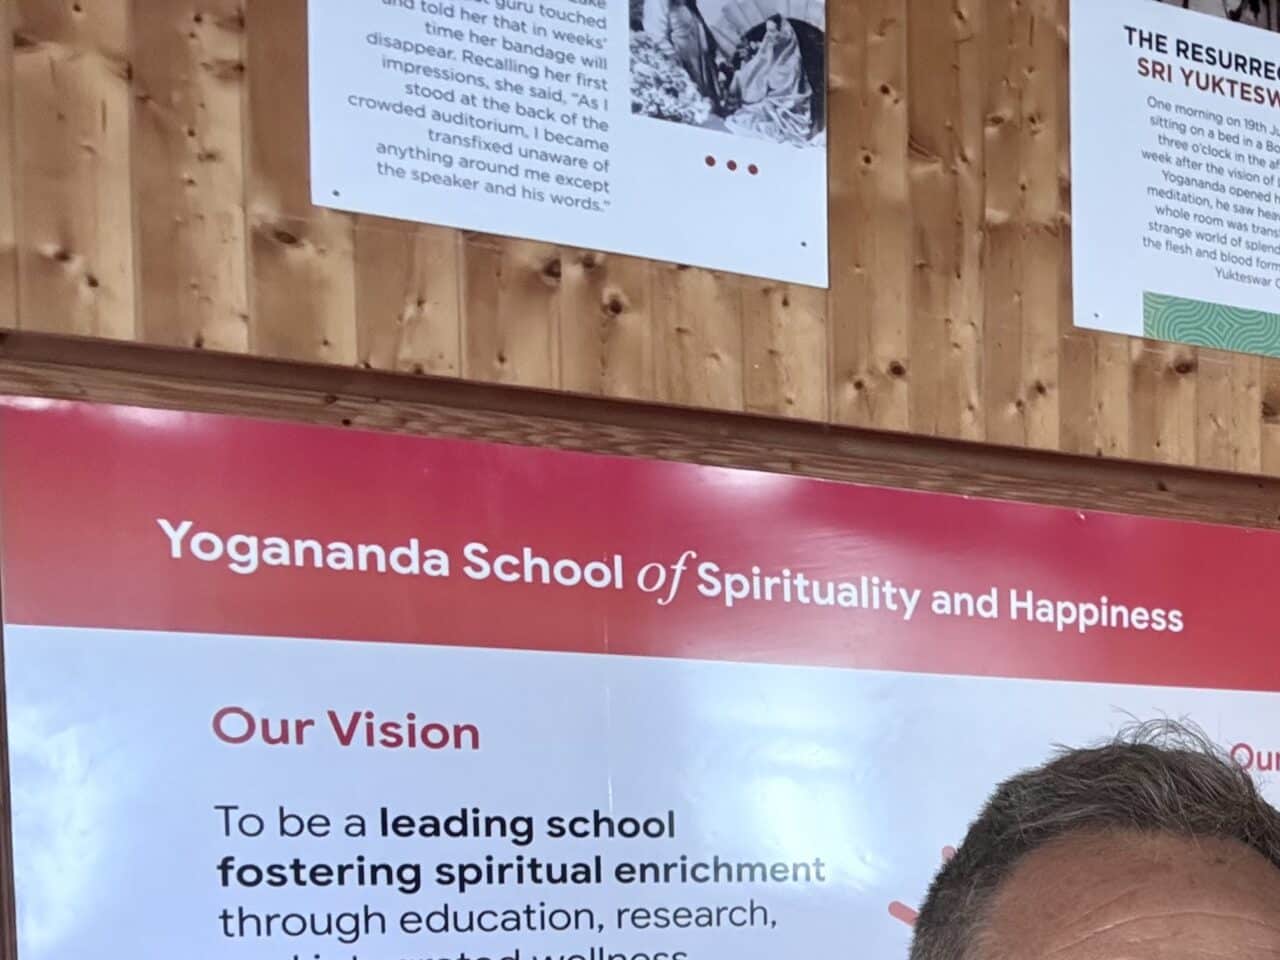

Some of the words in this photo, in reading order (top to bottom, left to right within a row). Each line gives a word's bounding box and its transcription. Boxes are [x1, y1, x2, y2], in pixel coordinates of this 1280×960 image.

[420, 0, 455, 18] told
[460, 7, 487, 24] her
[492, 14, 527, 34] that
[532, 23, 547, 37] in
[494, 0, 532, 14] guru
[538, 4, 607, 30] touched
[424, 21, 464, 41] time
[468, 28, 497, 46] her
[501, 35, 576, 64] bandage
[580, 55, 607, 69] will
[1123, 25, 1167, 54] THE
[382, 57, 490, 89] impressions,
[494, 77, 524, 95] she
[604, 98, 608, 110] I
[462, 48, 539, 80] Recalling
[544, 65, 571, 83] her
[576, 71, 607, 91] first
[1137, 57, 1172, 83] SRI
[347, 95, 426, 118] crowded
[534, 126, 538, 139] I
[543, 127, 609, 152] became
[404, 82, 455, 102] stood
[459, 93, 477, 107] at
[482, 96, 510, 113] the
[515, 101, 556, 122] back
[560, 112, 577, 125] of
[581, 115, 608, 132] the
[1146, 95, 1171, 112] One
[1174, 104, 1223, 125] morning
[1226, 116, 1241, 128] on
[1243, 117, 1267, 133] 19th
[376, 142, 453, 168] anything
[458, 156, 519, 176] around
[524, 168, 550, 182] me
[554, 173, 609, 194] except
[428, 128, 513, 155] transfixed
[518, 146, 588, 169] unaware
[592, 159, 609, 173] of
[1157, 133, 1188, 151] three
[1234, 151, 1245, 163] in
[1247, 153, 1266, 168] the
[376, 161, 406, 178] the
[411, 169, 479, 190] speaker
[484, 182, 516, 197] and
[521, 184, 544, 202] his
[1161, 169, 1226, 193] Yogananda
[1228, 185, 1271, 203] opened
[1154, 204, 1190, 221] whole
[1193, 212, 1224, 227] room
[1226, 219, 1248, 232] was
[1215, 197, 1230, 212] he
[1232, 203, 1254, 216] saw
[1148, 220, 1192, 239] strange
[1195, 231, 1227, 245] world
[1230, 235, 1242, 248] of
[157, 519, 450, 574] Yogananda
[463, 542, 622, 588] School
[637, 550, 696, 605] of
[698, 562, 921, 620] Spirituality
[932, 586, 998, 618] and
[1010, 589, 1184, 633] Happiness
[212, 706, 315, 744] Our
[327, 710, 480, 750] Vision
[214, 805, 264, 837] To
[279, 806, 330, 837] be
[344, 814, 366, 837] a
[380, 806, 534, 846] leading
[546, 809, 675, 838] school
[216, 856, 421, 894] fostering
[435, 854, 601, 893] spiritual
[614, 855, 826, 884] enrichment
[218, 904, 386, 944] through
[400, 902, 604, 934] education,
[617, 899, 776, 929] research,
